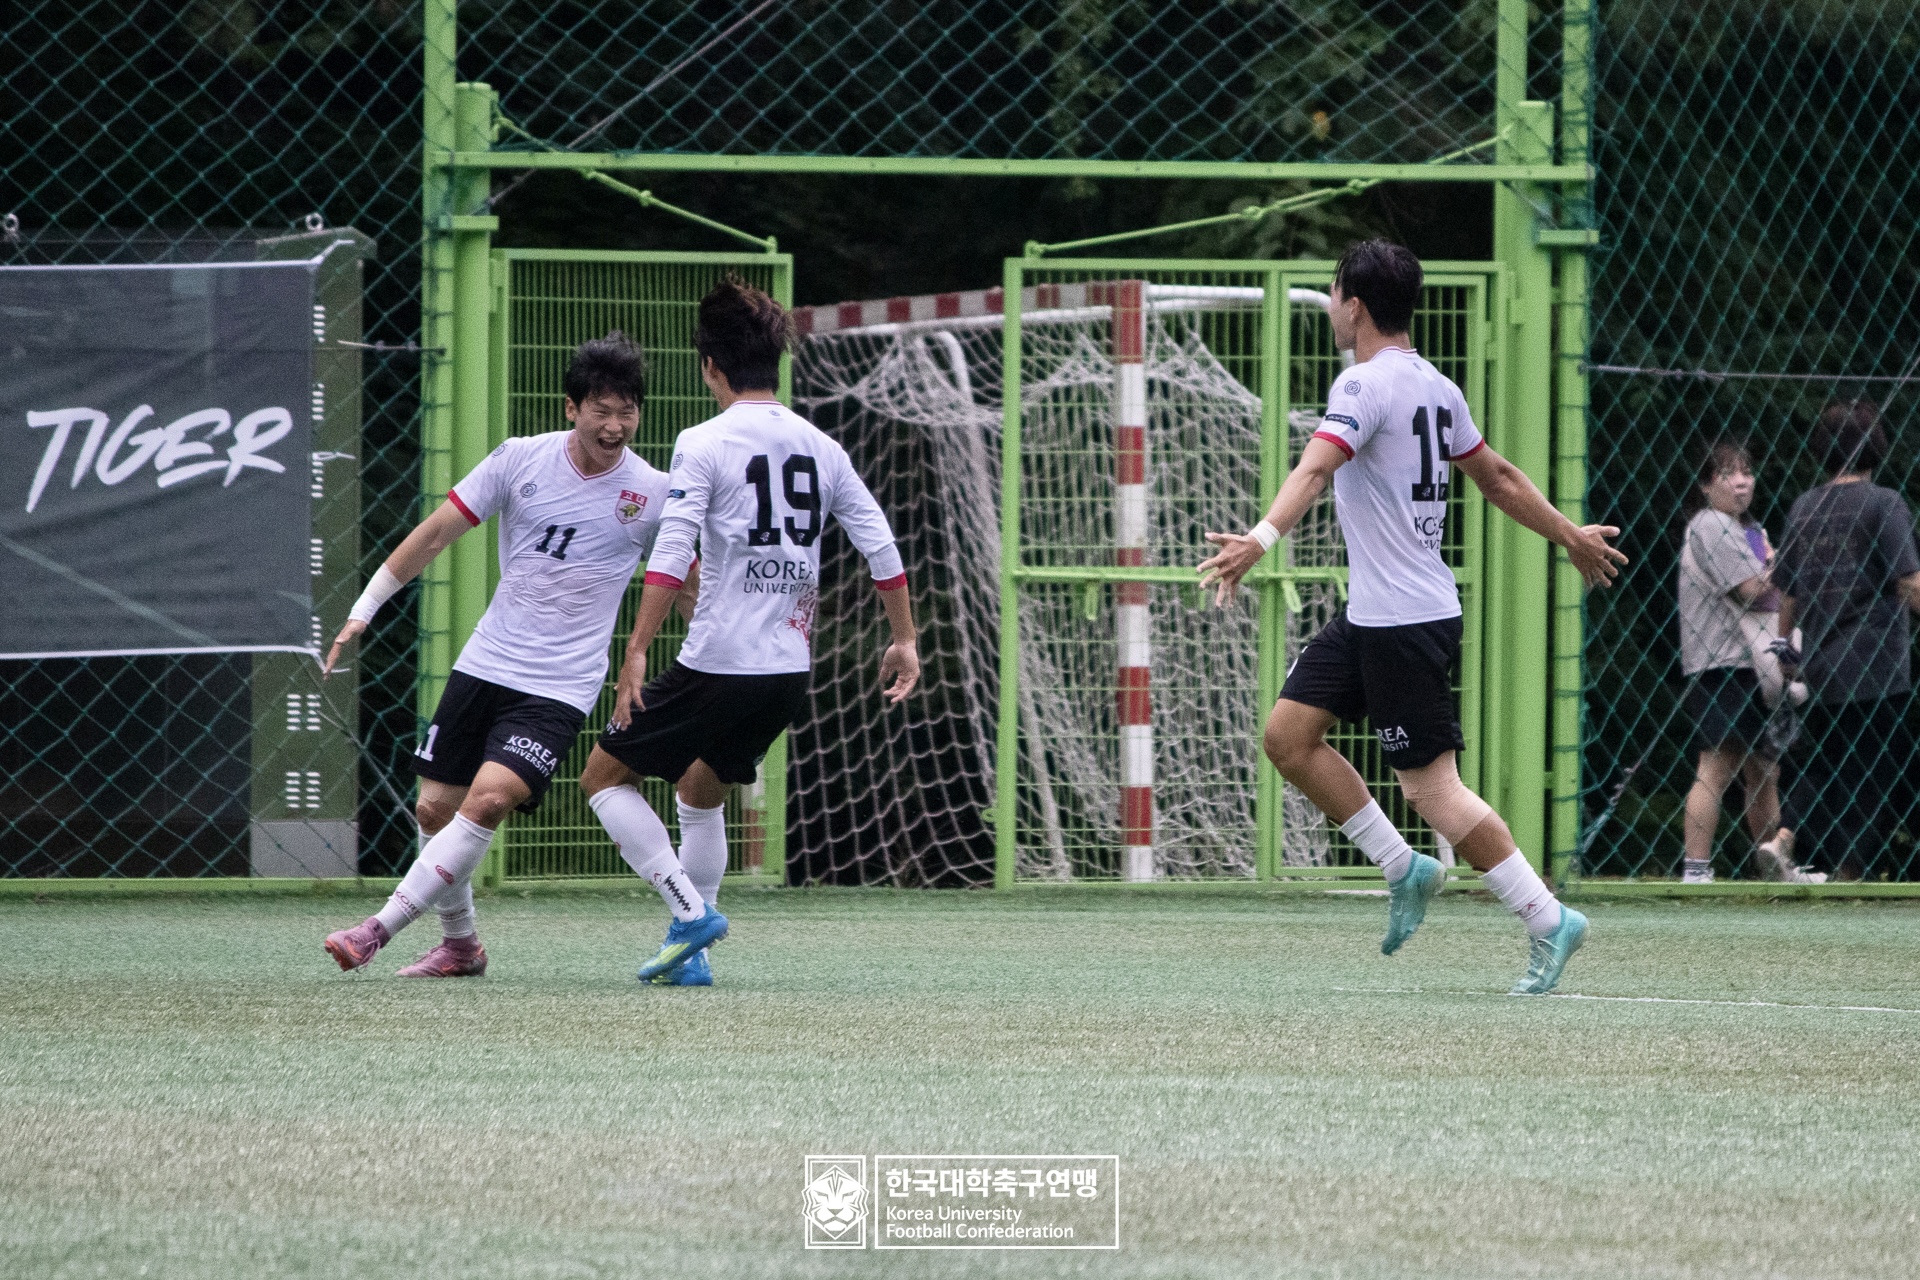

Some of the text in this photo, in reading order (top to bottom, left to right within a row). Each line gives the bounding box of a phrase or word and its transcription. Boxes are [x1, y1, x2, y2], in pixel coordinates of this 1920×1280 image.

[26, 404, 293, 514] TIGER
[745, 453, 821, 547] 19
[535, 524, 577, 561] 11
[746, 559, 816, 581] KOREA
[503, 745, 551, 777] UNIVERSITY
[506, 735, 558, 771] KOREA
